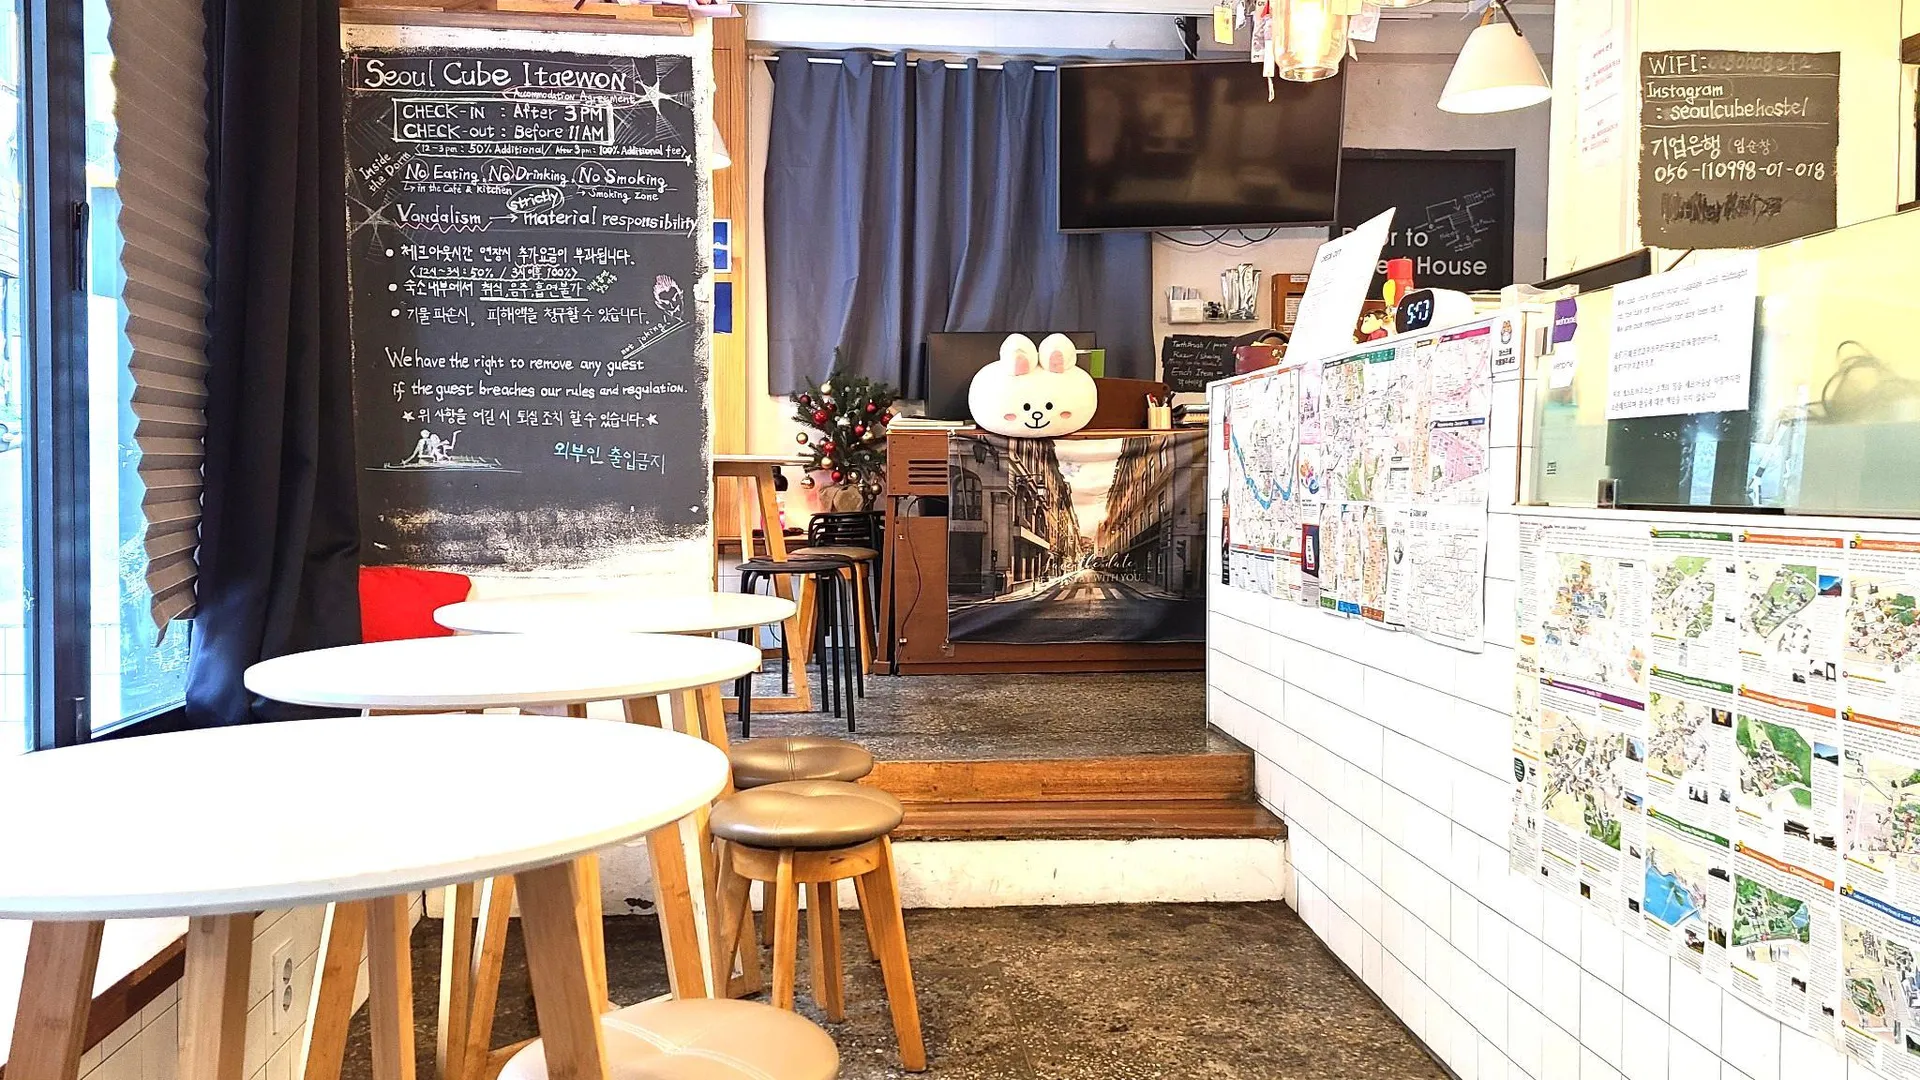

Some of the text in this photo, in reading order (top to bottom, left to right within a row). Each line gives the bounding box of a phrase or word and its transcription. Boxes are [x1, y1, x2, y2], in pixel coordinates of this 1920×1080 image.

[364, 59, 436, 87] Seoul
[443, 61, 512, 87] Cube
[1646, 82, 1724, 104] Instagram
[402, 103, 486, 120] CHECK-IN
[513, 104, 558, 121] After
[1669, 97, 1809, 121] seoulcubehostel
[514, 124, 563, 141] Before
[468, 143, 492, 154] 50%
[620, 144, 664, 156] Additional
[1650, 134, 1721, 160] 기업은행
[358, 152, 392, 180] Inside
[368, 151, 411, 192] the Dorm
[404, 163, 427, 181] No
[488, 165, 511, 183] No
[578, 166, 601, 184] No
[604, 168, 669, 193] Smoking
[417, 183, 427, 193] in
[428, 182, 441, 193] the
[396, 188, 698, 239] Vandalism strictly material responsibility
[1405, 227, 1429, 248] to
[400, 244, 636, 265] 체크아웃시간 연장시 추가요금이 부과됩니다.
[470, 266, 495, 279] 50%
[1417, 255, 1488, 277] House
[403, 280, 475, 298] 숙소내부에서
[486, 306, 538, 326] 피해액을
[598, 307, 650, 326] 있습니다.
[620, 314, 671, 356] not joking!
[384, 346, 645, 378] We have the right to remove any guest
[392, 380, 406, 402] if
[410, 379, 434, 396] the
[435, 383, 474, 403] guest
[478, 380, 536, 398] breaches
[540, 386, 562, 398] our
[565, 382, 596, 399] rules
[599, 384, 620, 396] and
[417, 408, 432, 424] 위
[434, 407, 469, 426] 사항을
[473, 408, 496, 427] 어길
[499, 409, 511, 427] 시
[516, 409, 540, 428] 퇴실
[541, 410, 565, 427] 조치
[600, 411, 646, 429] 있습니다.
[553, 441, 667, 476] 외부인 출입금지
[1105, 552, 1134, 569] date
[1093, 574, 1118, 583] WITH
